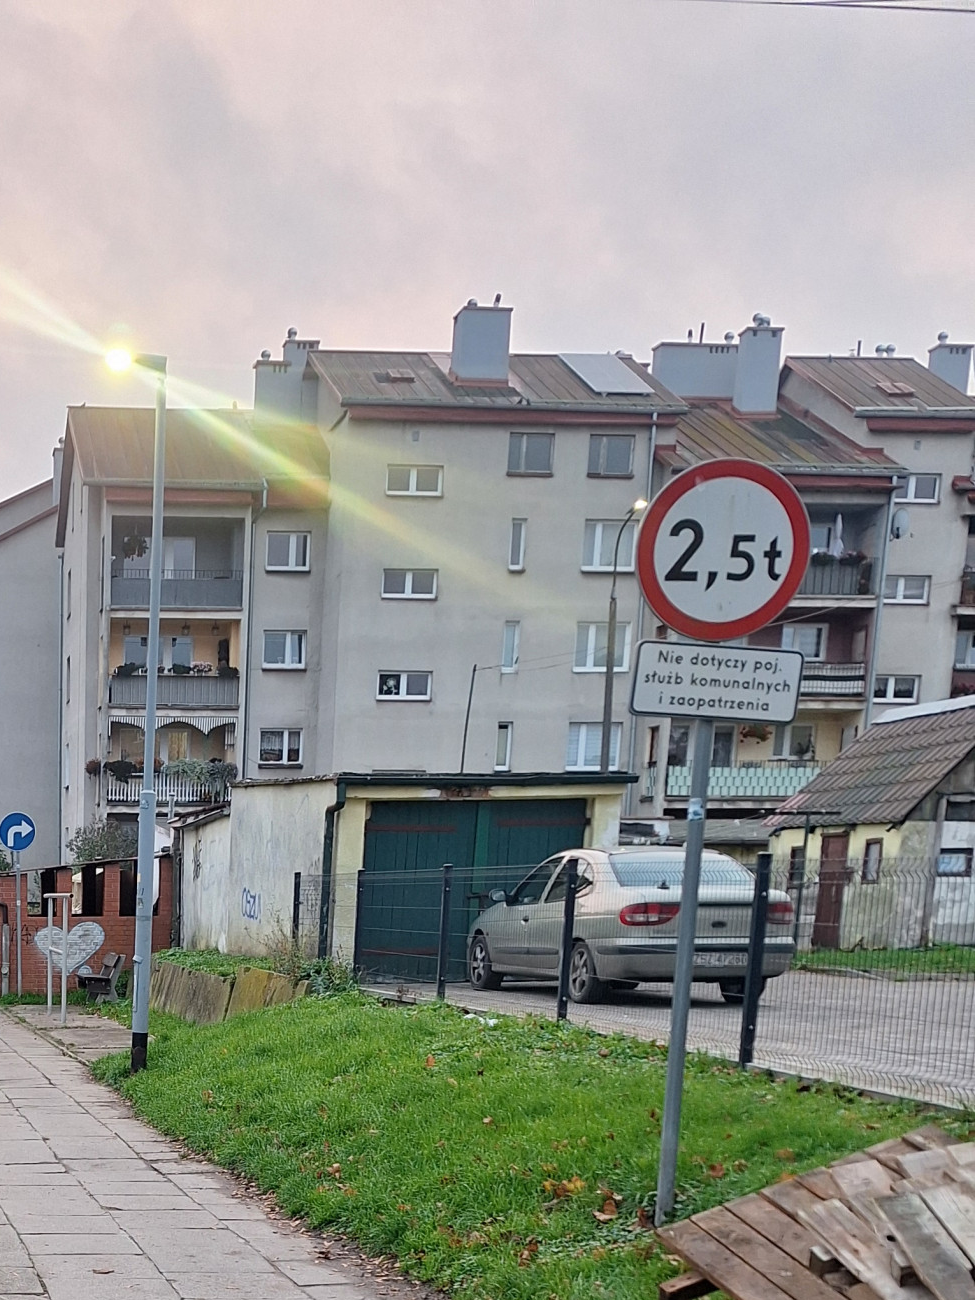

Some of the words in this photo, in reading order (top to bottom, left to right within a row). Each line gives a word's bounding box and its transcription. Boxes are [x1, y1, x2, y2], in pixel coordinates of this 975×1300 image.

[664, 518, 783, 592] 2,5t
[658, 650, 683, 665] Nie
[690, 653, 747, 672] dotyczy
[754, 658, 783, 674] poj.
[644, 671, 683, 685] służb
[690, 673, 791, 694] komunalnych
[658, 691, 663, 704] i
[669, 695, 770, 711] zaopatrzenia
